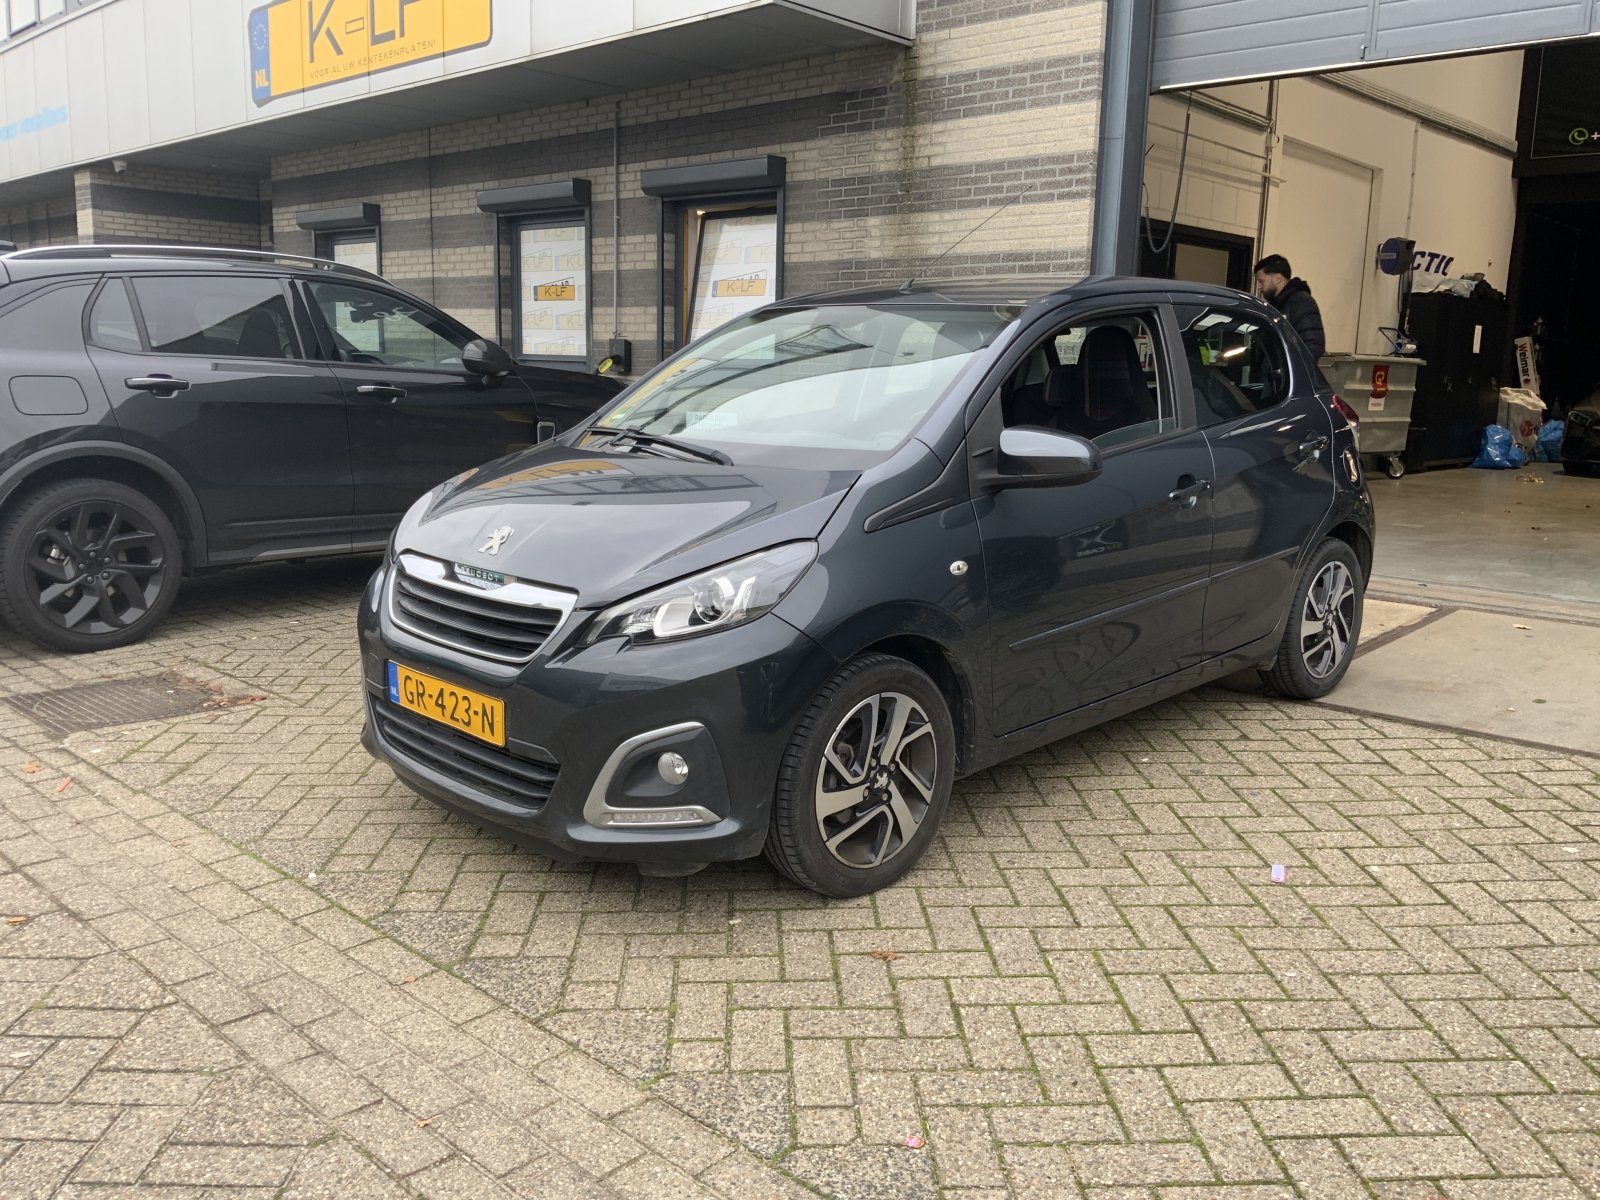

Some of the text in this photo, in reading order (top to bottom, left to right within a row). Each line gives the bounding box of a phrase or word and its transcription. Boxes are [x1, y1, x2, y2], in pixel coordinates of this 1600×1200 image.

[309, 39, 436, 79] VOOR AL UW KENTEKENPLATEN!
[255, 69, 269, 88] NL
[544, 286, 567, 297] K-LF
[726, 280, 756, 293] K-LF
[1518, 342, 1530, 378] Weimar
[460, 566, 500, 581] PEUGEOT
[403, 674, 495, 737] GR-423-N
